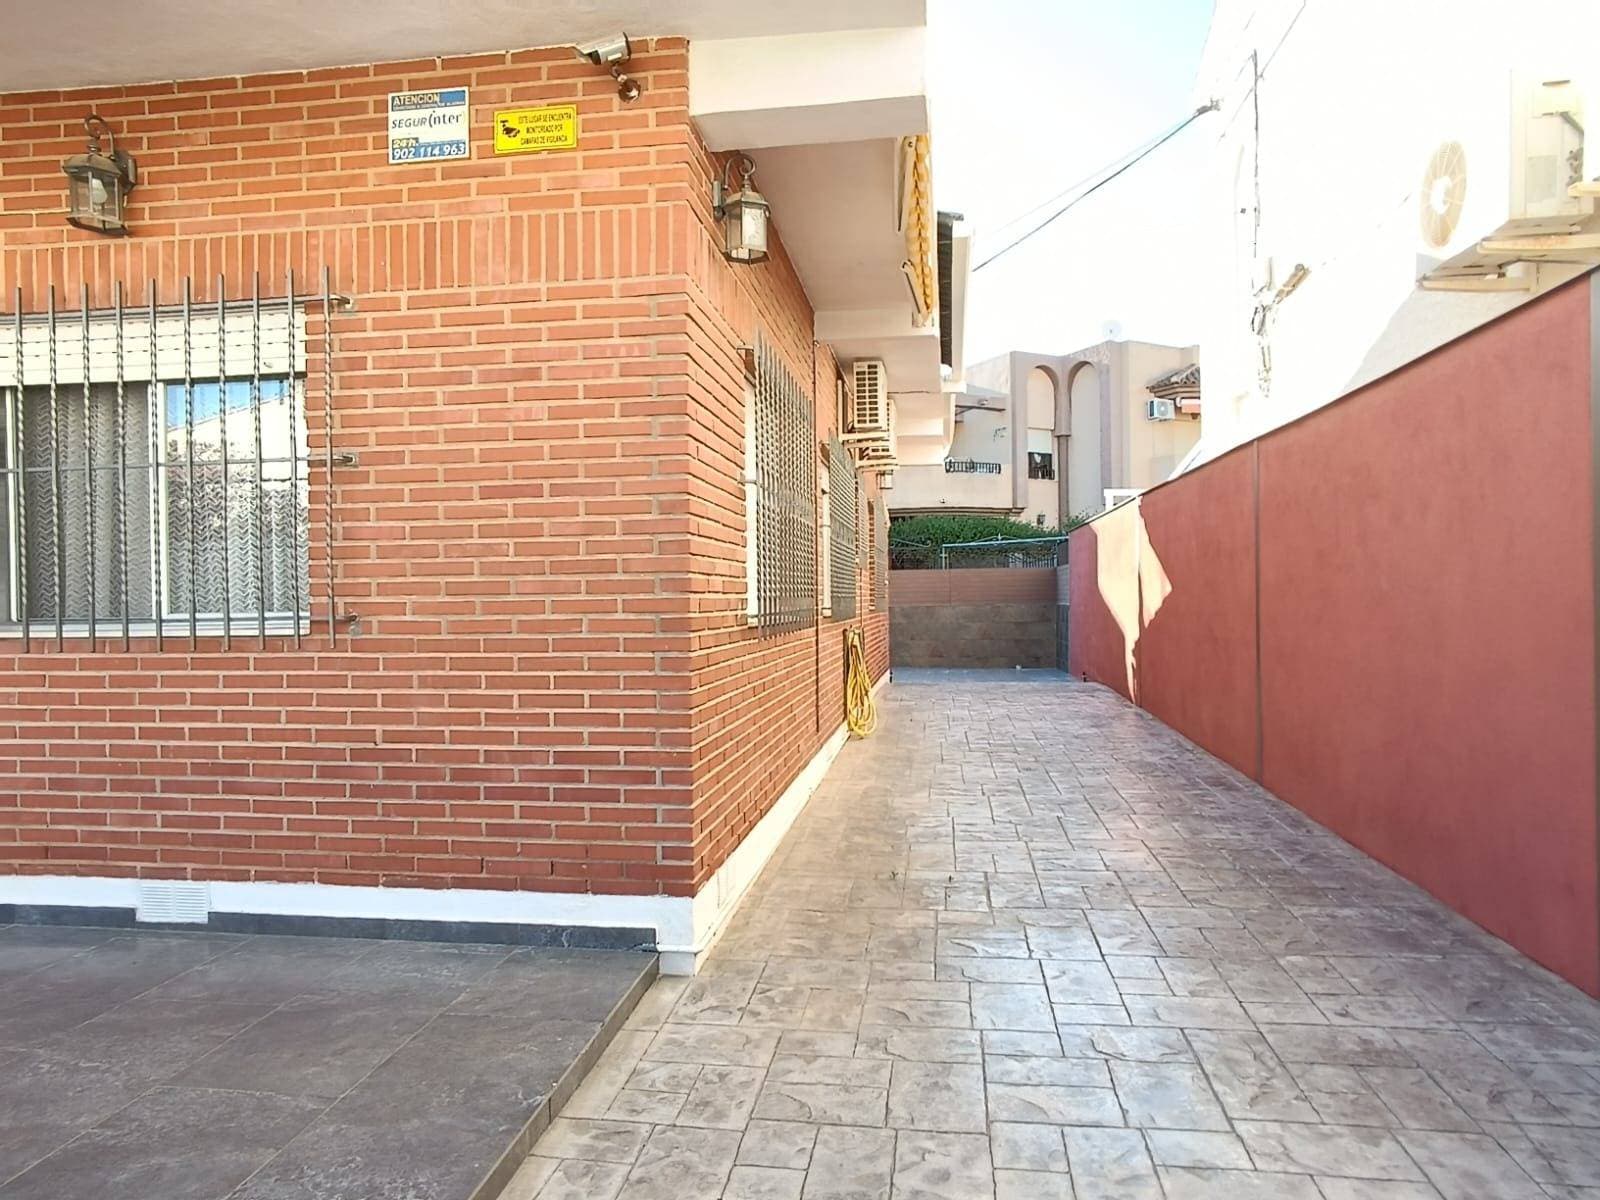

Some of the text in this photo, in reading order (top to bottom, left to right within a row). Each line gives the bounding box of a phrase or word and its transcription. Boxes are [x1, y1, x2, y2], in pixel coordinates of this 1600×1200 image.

[393, 147, 416, 160] 902
[420, 146, 441, 157] 114
[443, 143, 465, 155] 963
